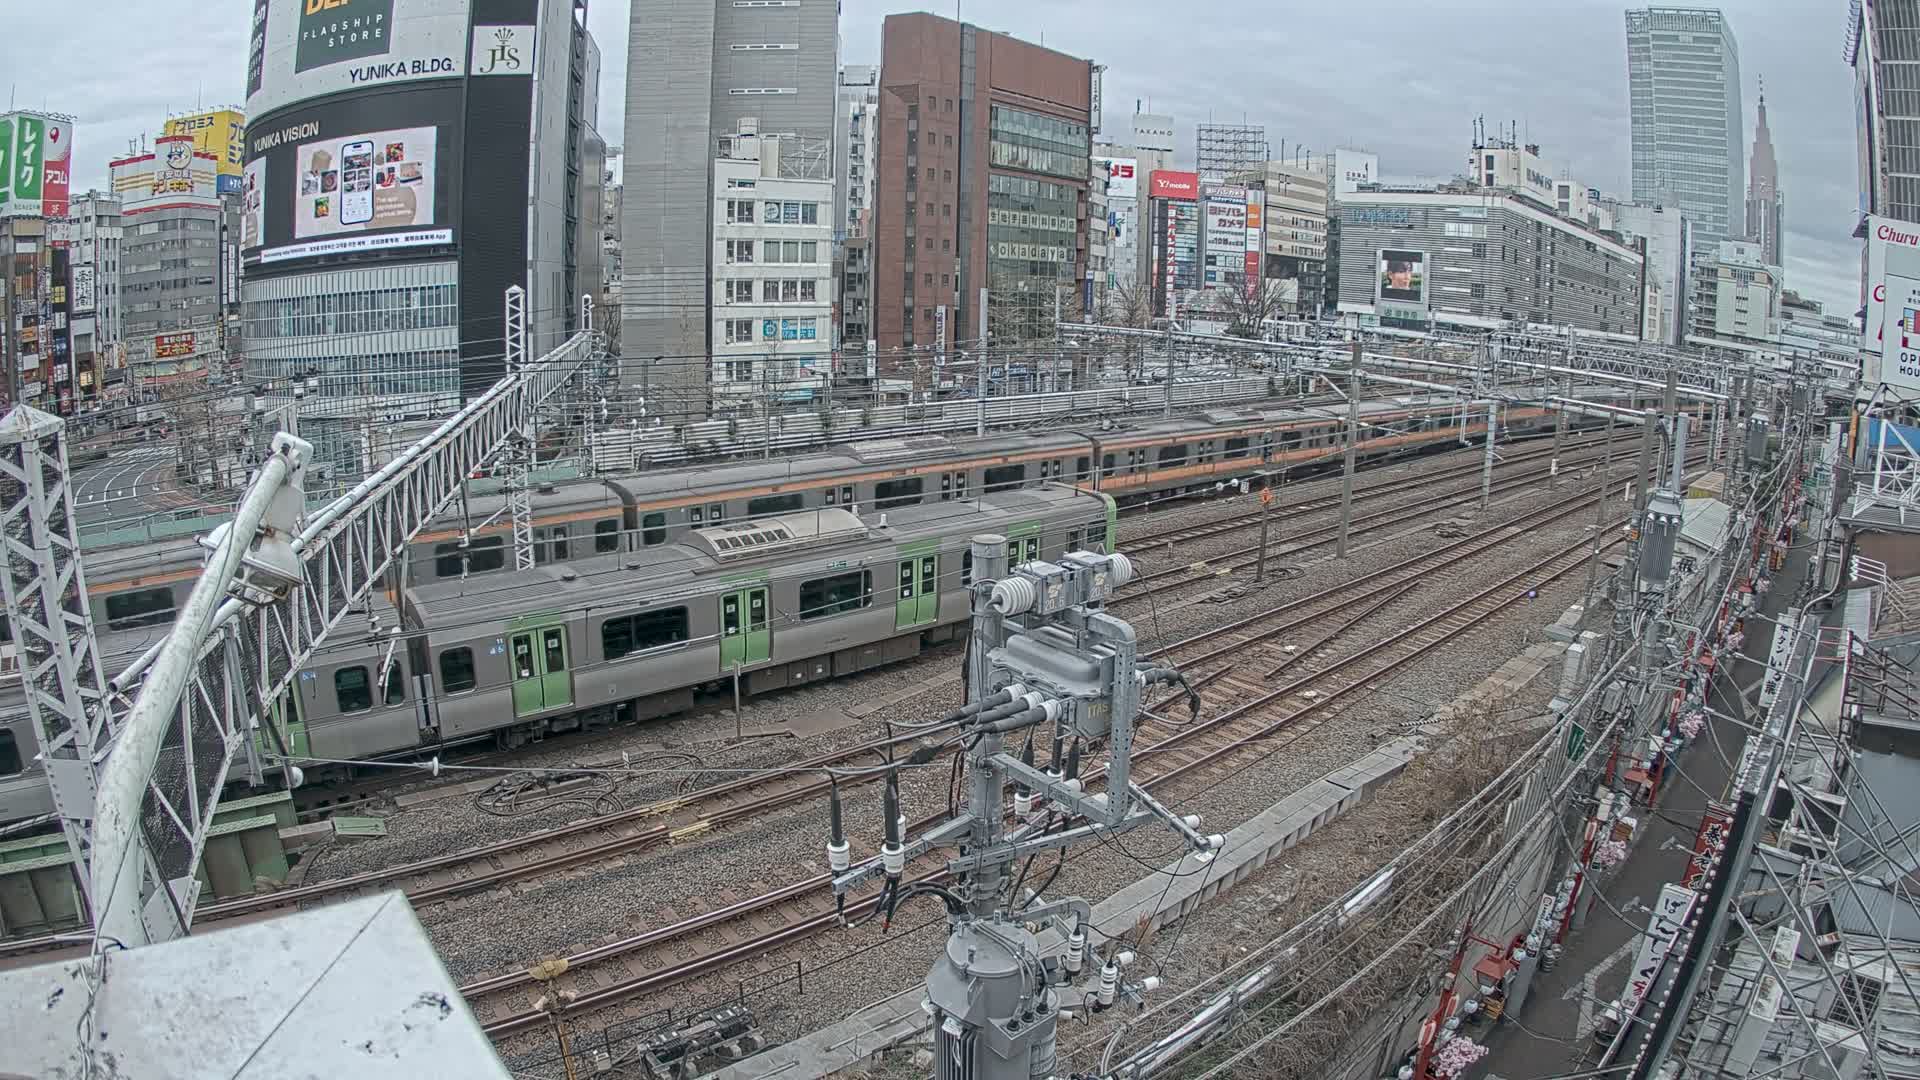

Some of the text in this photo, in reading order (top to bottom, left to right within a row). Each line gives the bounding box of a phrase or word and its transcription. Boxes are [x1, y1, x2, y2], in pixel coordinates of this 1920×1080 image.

[303, 14, 383, 40] FLAGSHIP
[328, 28, 382, 47] STORE
[349, 57, 456, 83] YUNIKA BLDG.
[176, 116, 214, 133] プロミス
[1134, 127, 1173, 137] TAKANO
[254, 120, 319, 153] YUNIKA VISION
[21, 121, 37, 188] レイク
[45, 169, 68, 185] アコム
[1217, 217, 1245, 229] カメラ
[1877, 224, 1919, 246] Churu
[1000, 243, 1065, 262] okadaya
[1900, 351, 1920, 366] OP
